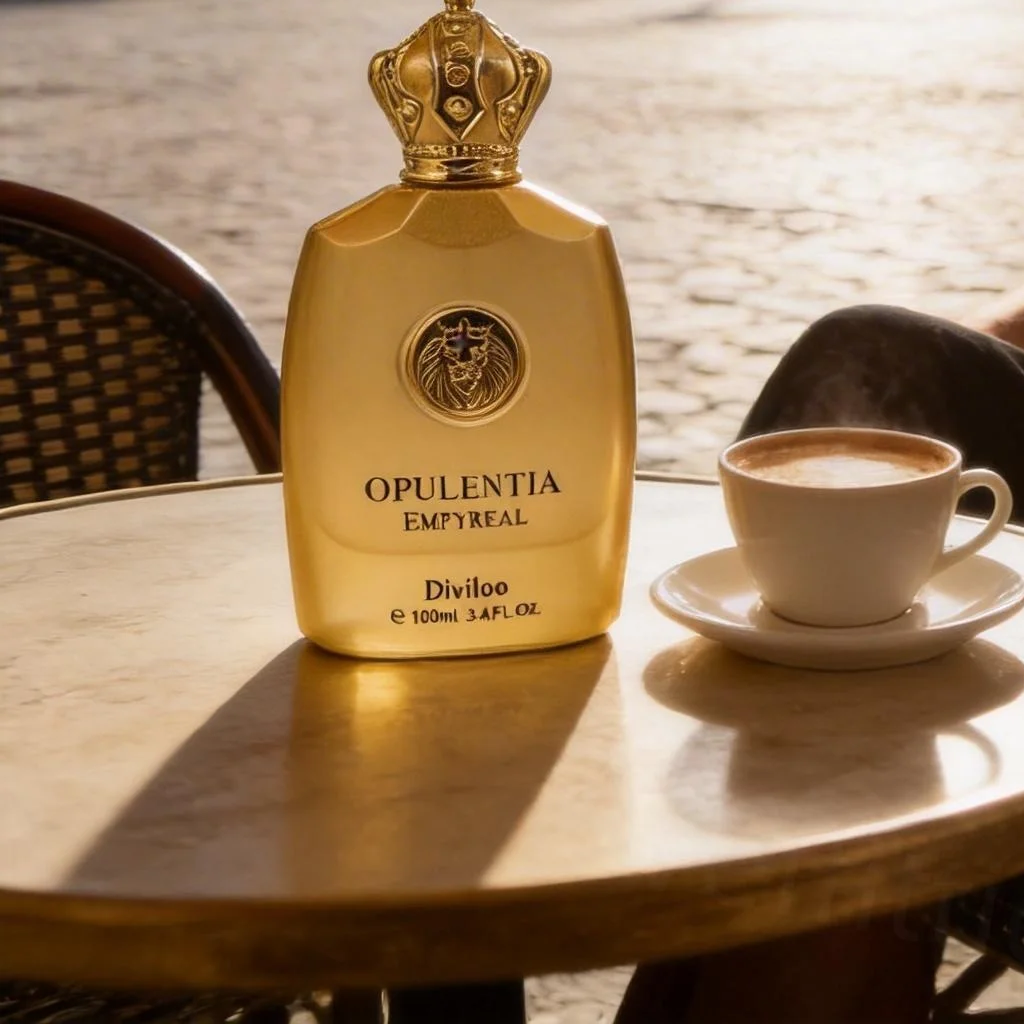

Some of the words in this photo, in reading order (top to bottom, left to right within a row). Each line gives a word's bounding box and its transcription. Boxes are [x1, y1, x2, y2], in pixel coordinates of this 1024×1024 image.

[364, 470, 561, 503] OPULENTIA
[404, 508, 528, 532] EMPYREAL
[425, 576, 508, 601] Diviloo
[412, 609, 458, 625] 100ml
